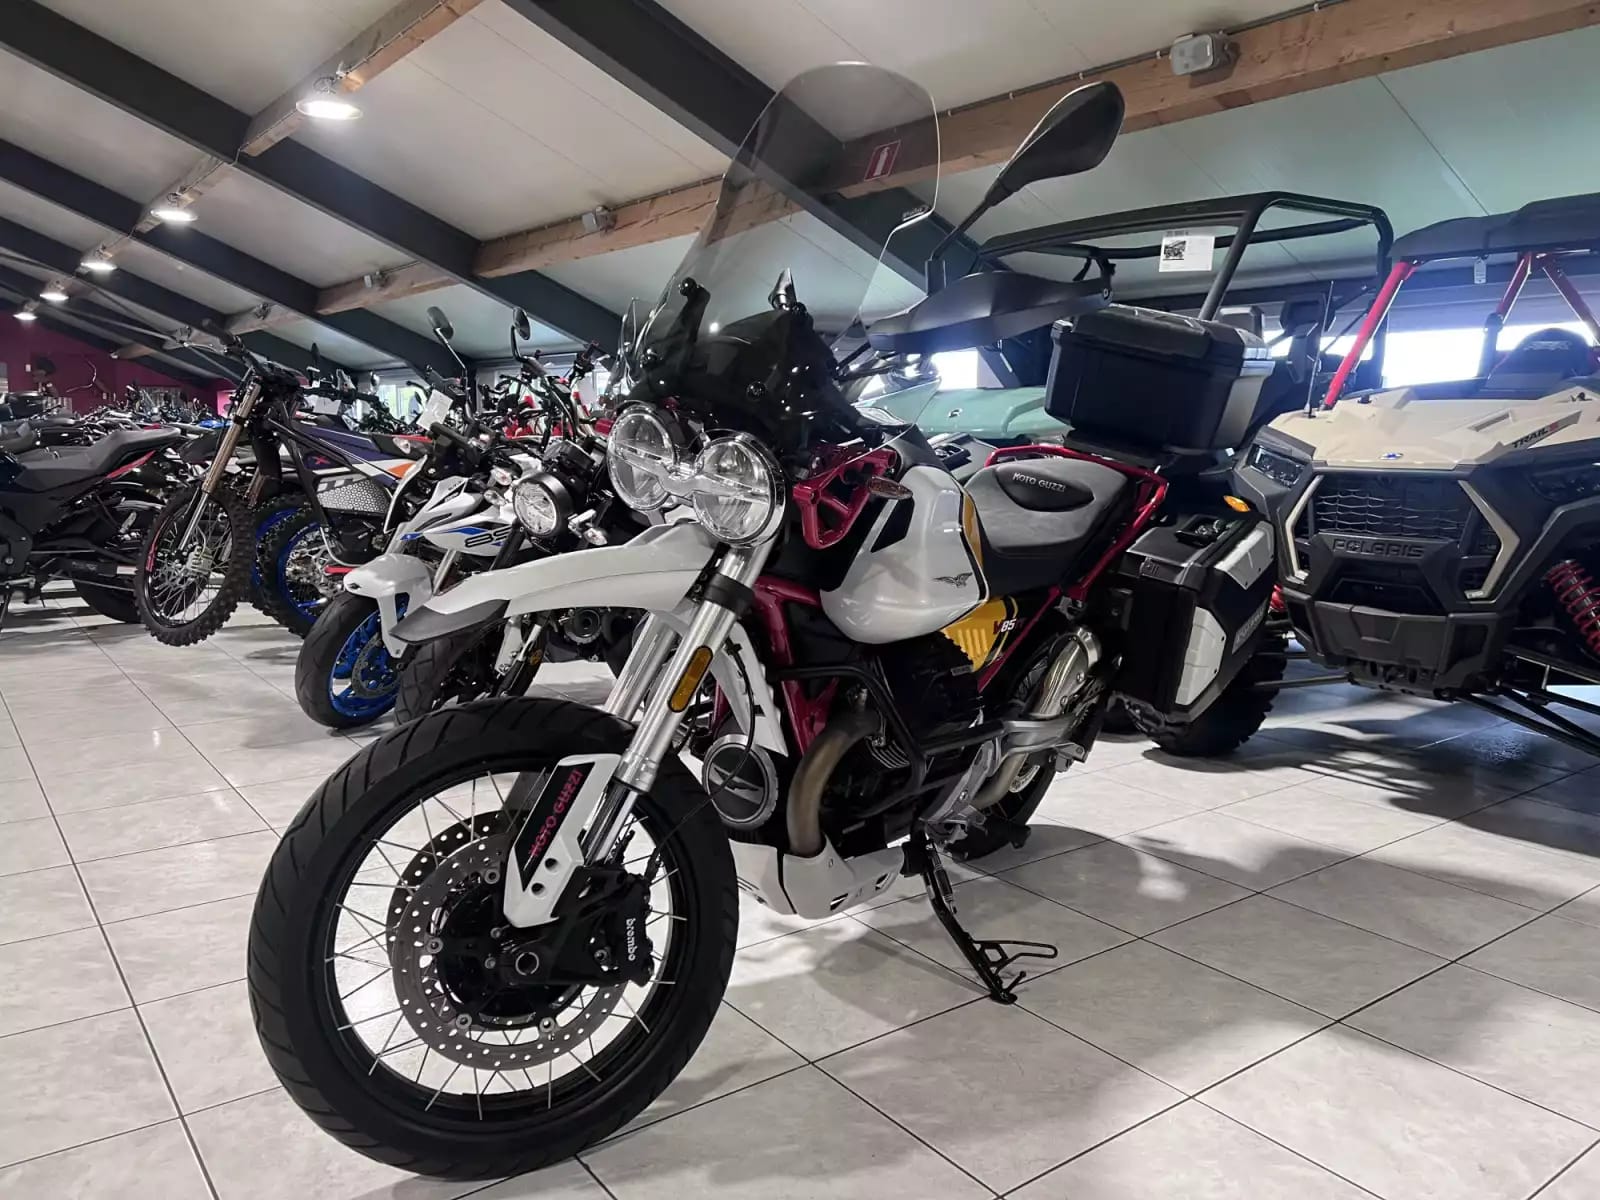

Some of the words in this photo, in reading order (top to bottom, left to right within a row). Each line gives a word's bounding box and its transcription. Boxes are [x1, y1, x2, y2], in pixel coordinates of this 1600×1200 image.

[1512, 427, 1548, 448] TRAIL
[1012, 472, 1037, 485] MOTO
[1038, 479, 1066, 493] GUZZI
[1332, 538, 1425, 559] POLARIS
[529, 815, 557, 857] MOTO
[553, 769, 584, 814] GUZZI
[626, 917, 638, 961] brembo
